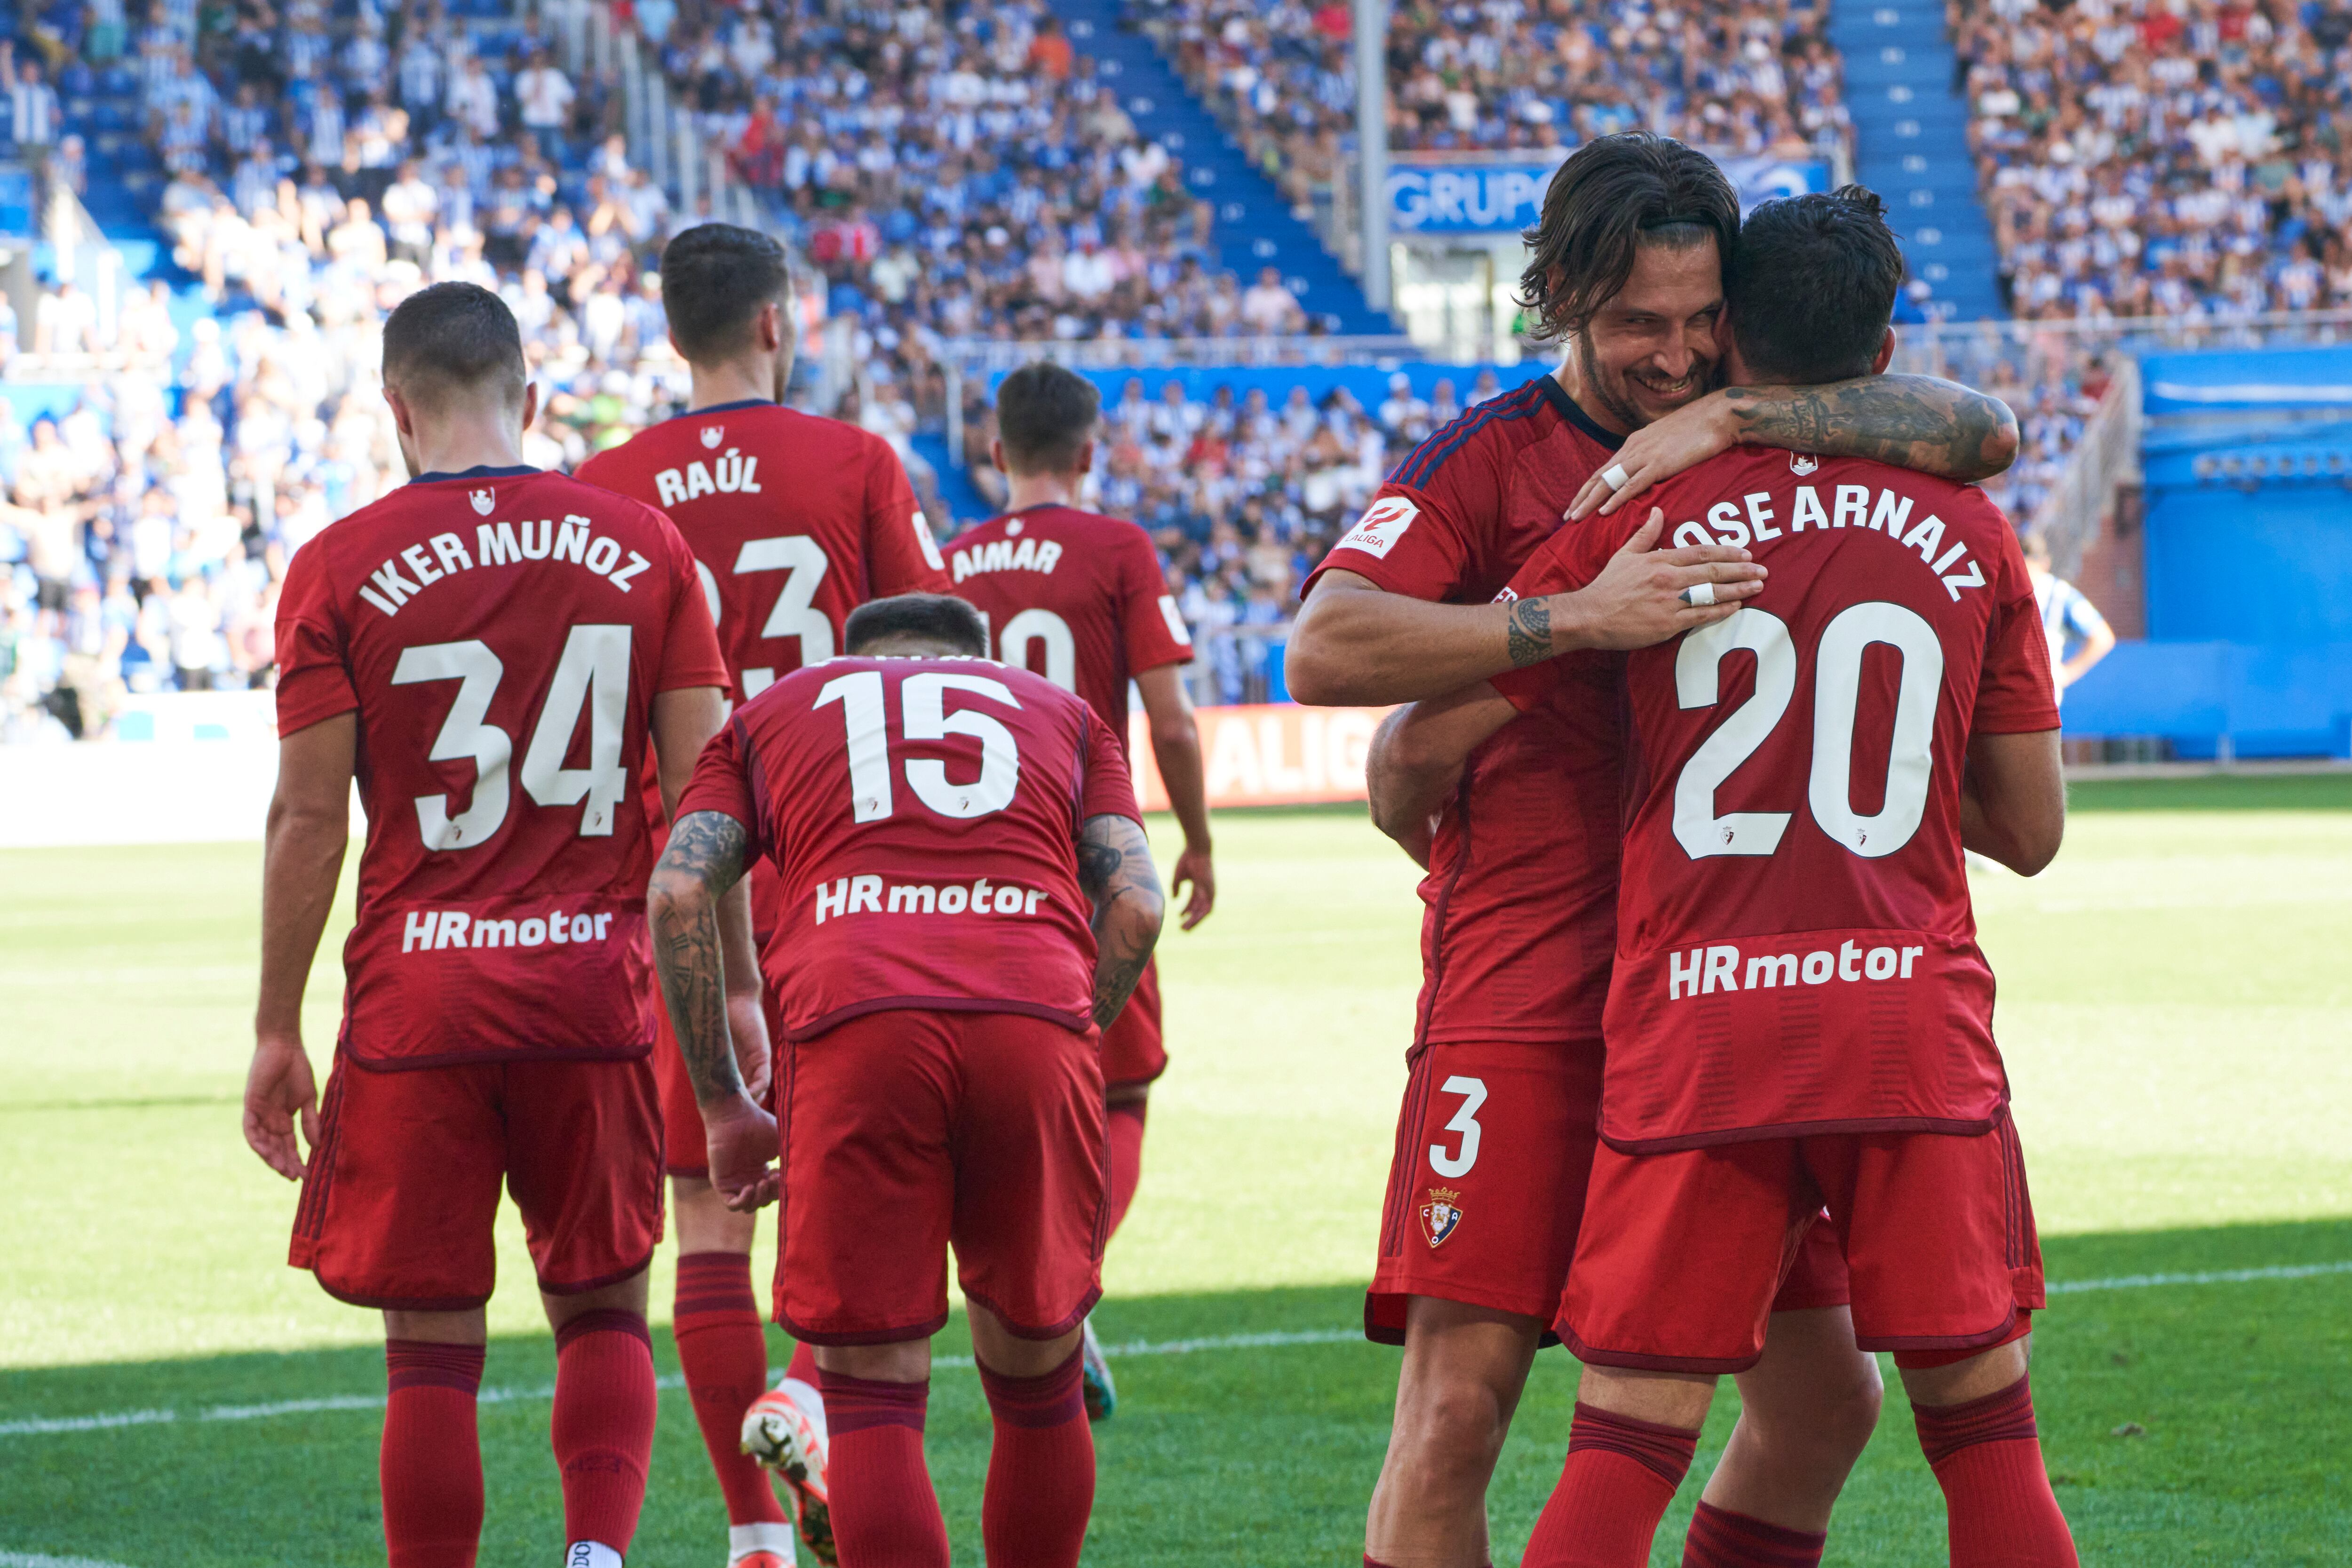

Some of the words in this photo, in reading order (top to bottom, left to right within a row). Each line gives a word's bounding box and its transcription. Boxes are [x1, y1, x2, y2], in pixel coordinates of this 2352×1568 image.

[655, 447, 761, 507] RAÚL
[359, 533, 473, 616] IKER
[477, 514, 651, 593] MUÑOZ
[952, 538, 1063, 584] AIMAR
[1344, 534, 1385, 548] LALIGA
[1658, 492, 1783, 550] OSE
[1792, 485, 1986, 602] ARNAIZ
[977, 608, 1076, 693] 0
[391, 624, 632, 851] 34
[812, 670, 1023, 824] 15
[1207, 711, 1376, 796] ALIG
[1672, 600, 1944, 860] 20
[1429, 1075, 1488, 1178] 3
